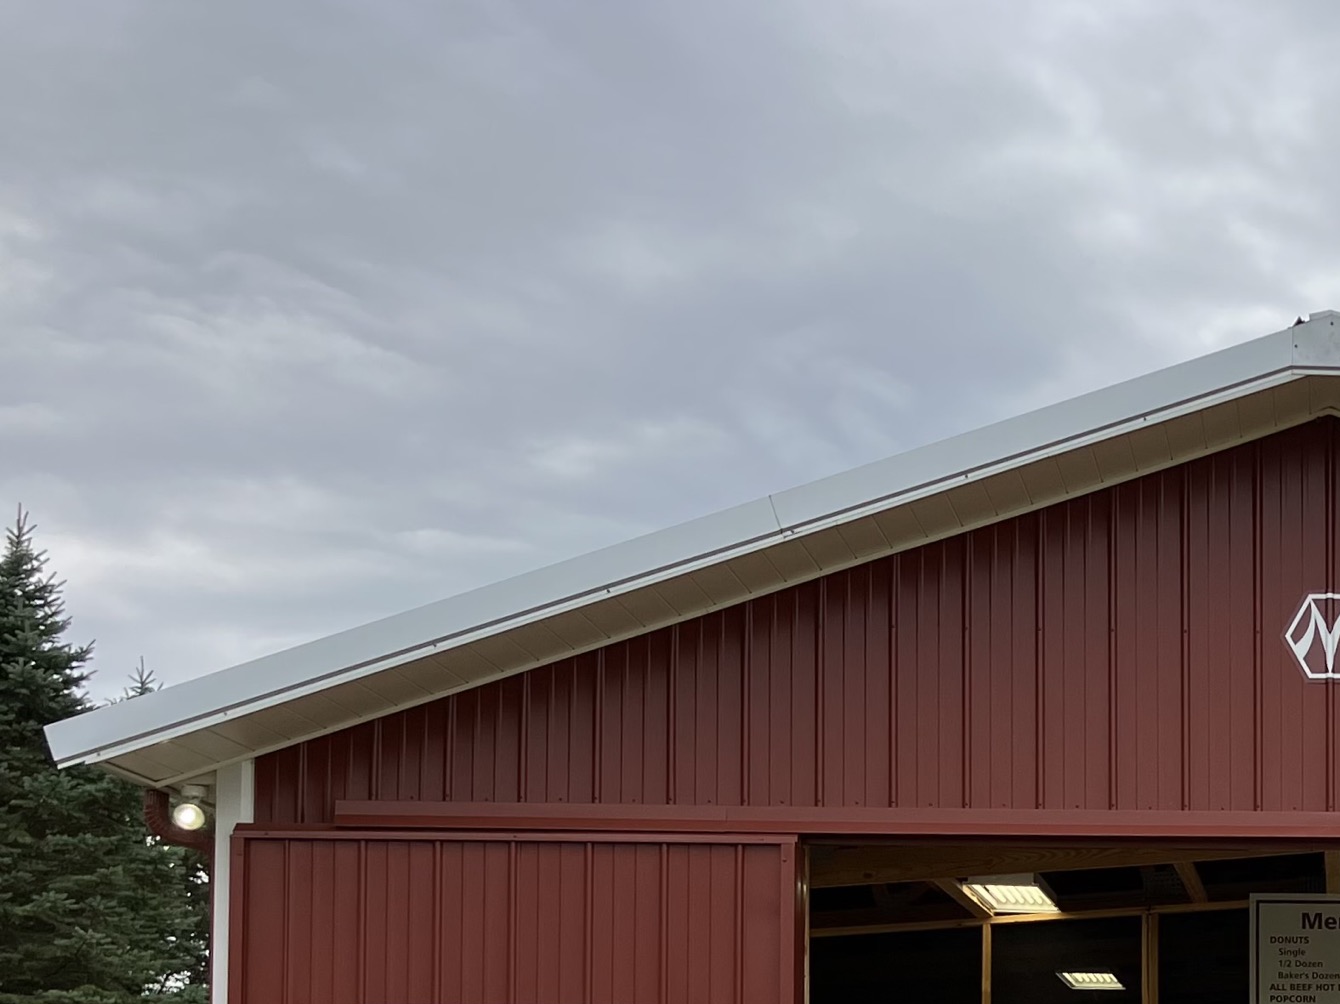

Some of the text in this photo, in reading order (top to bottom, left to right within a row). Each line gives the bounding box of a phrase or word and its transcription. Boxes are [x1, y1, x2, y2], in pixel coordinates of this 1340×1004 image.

[1270, 936, 1309, 944] DONUTS
[1279, 948, 1306, 957] Single
[1279, 960, 1292, 968] 1/2
[1295, 960, 1323, 968] Dozen
[1270, 995, 1316, 1003] POPCORN
